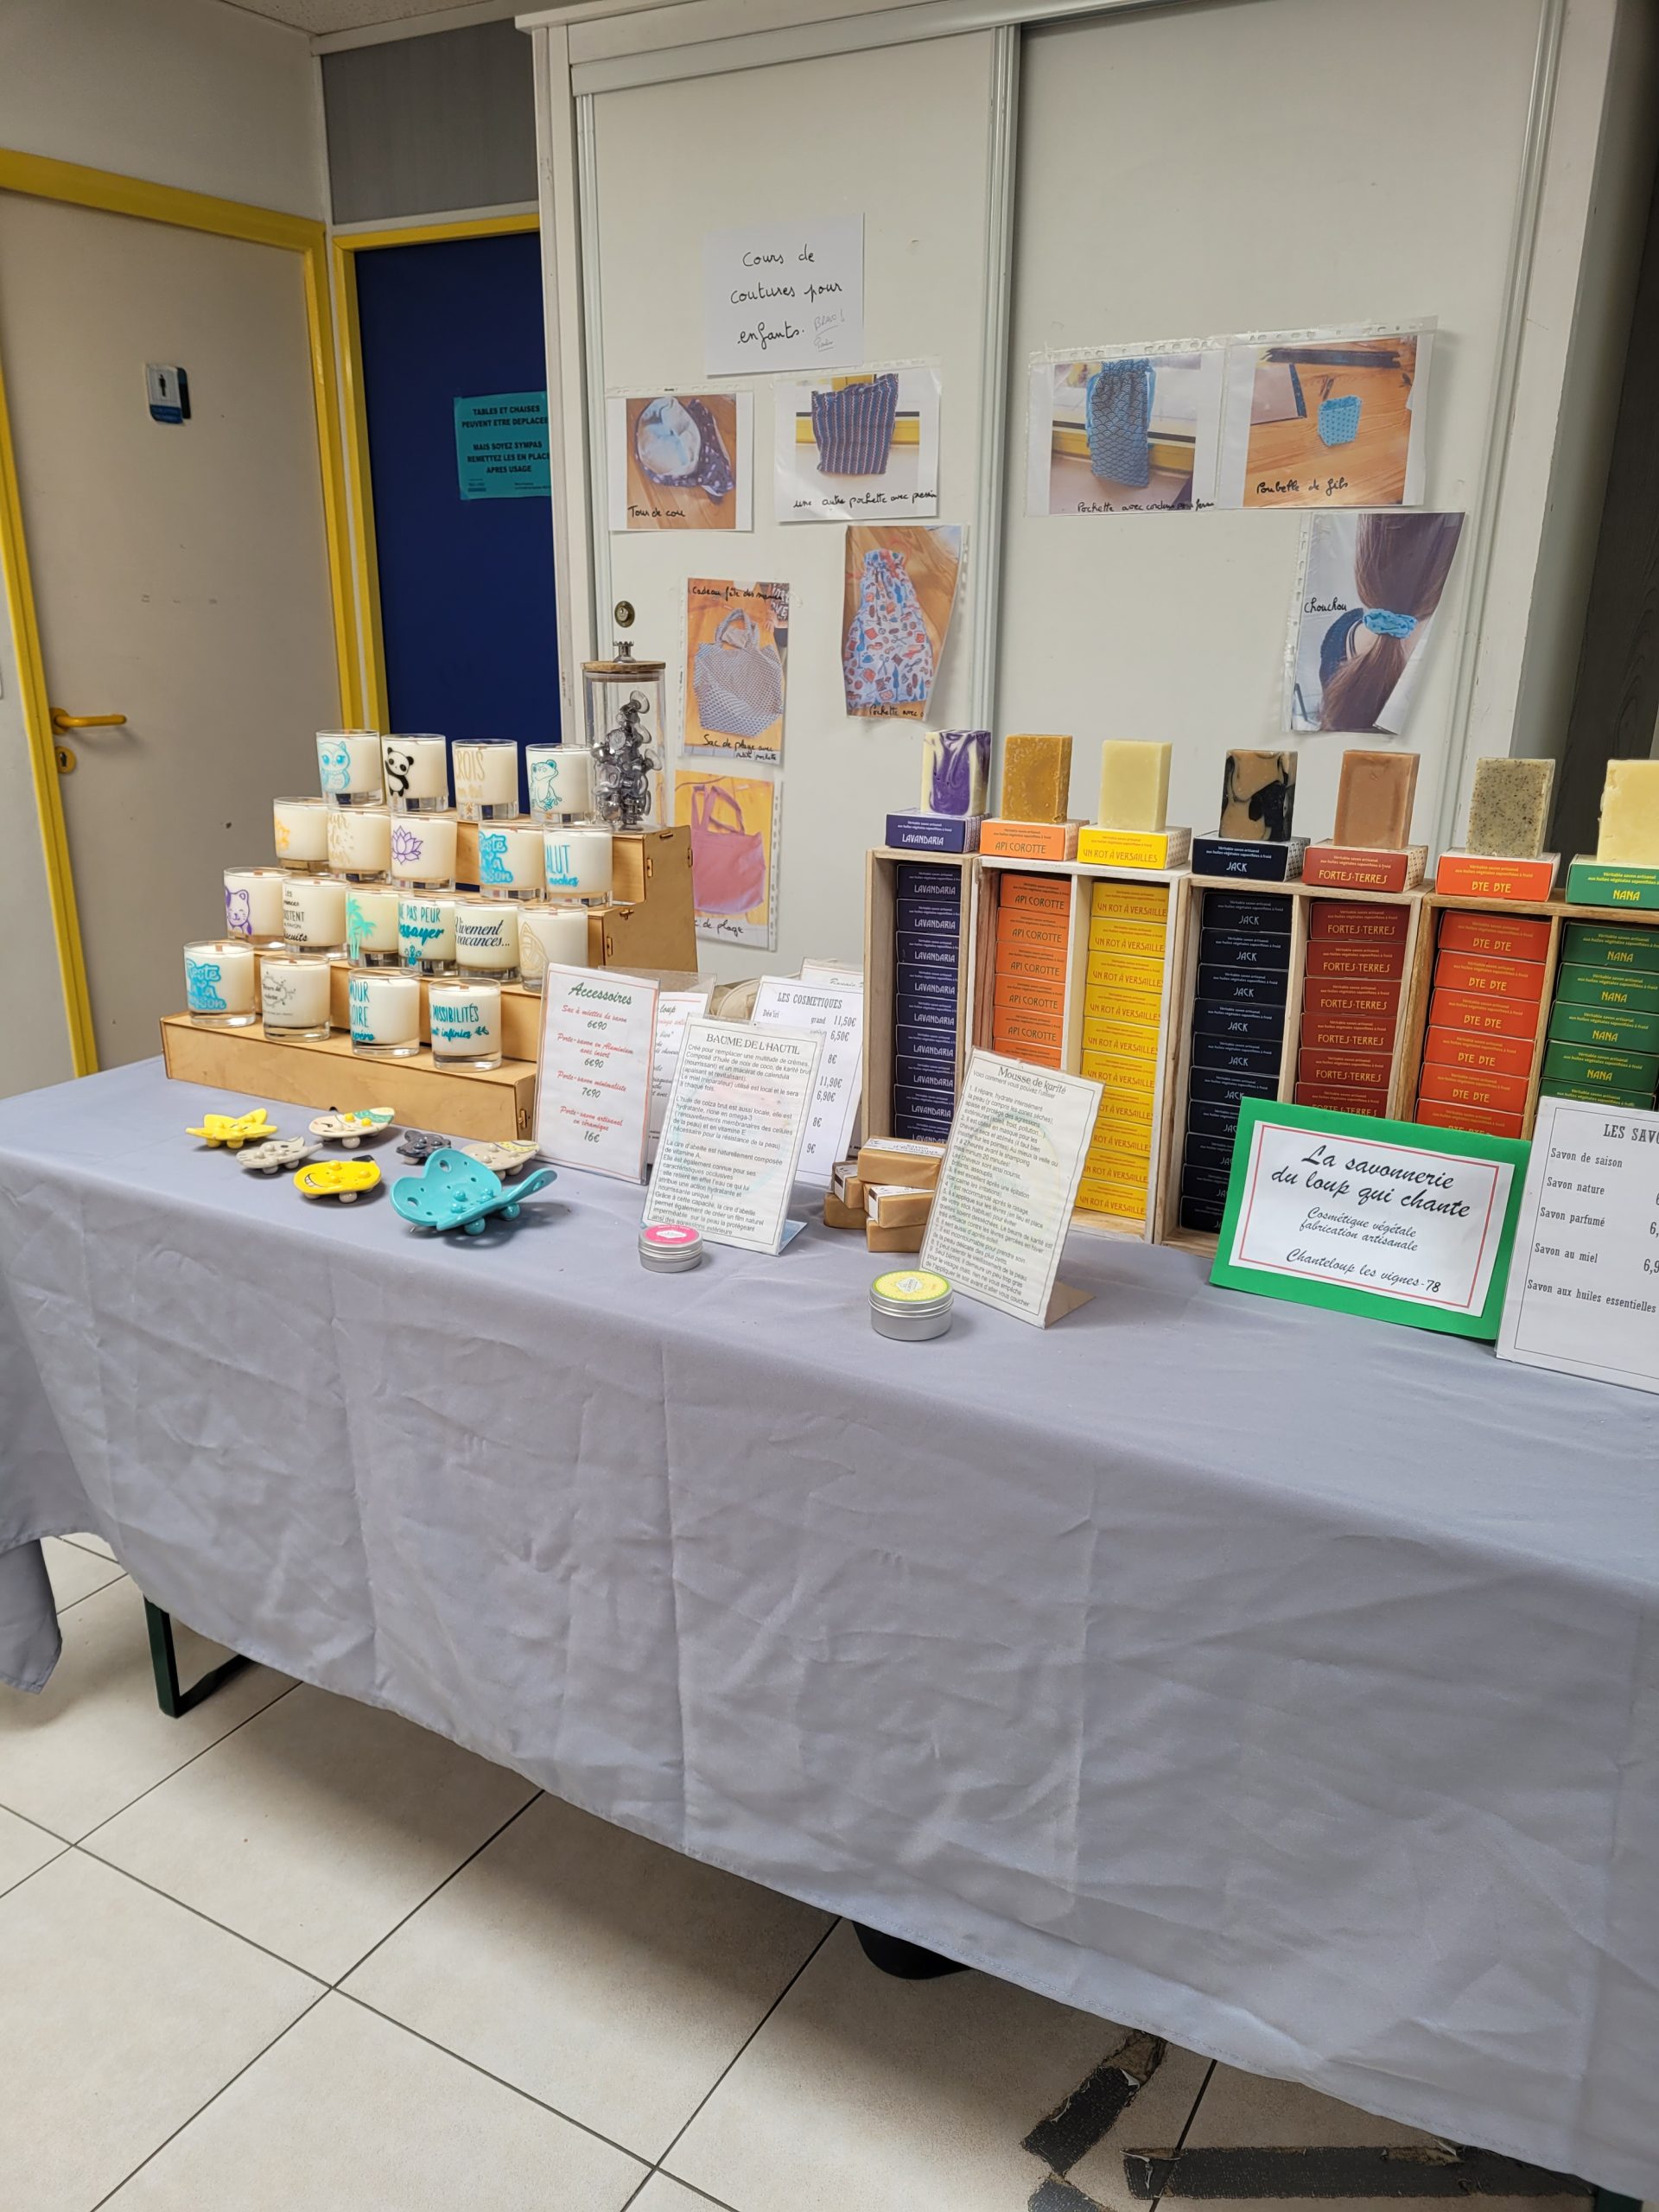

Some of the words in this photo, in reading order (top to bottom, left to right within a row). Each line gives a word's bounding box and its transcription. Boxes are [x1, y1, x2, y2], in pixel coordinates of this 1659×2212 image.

[742, 251, 784, 267] Cours
[798, 243, 815, 263] de
[730, 282, 796, 304] coutures
[804, 283, 842, 302] pour
[473, 407, 498, 416] TABLES
[510, 404, 540, 414] CHAISES
[461, 419, 492, 429] PEUVENT
[473, 443, 490, 452] MAIS
[515, 441, 543, 449] SYMPAS
[467, 454, 501, 463] REMETTEZ
[1308, 479, 1319, 491] de
[1325, 477, 1348, 496] fils
[627, 505, 650, 518] Tour
[652, 508, 662, 518] de
[1077, 501, 1114, 512] Pochette
[692, 587, 721, 595] Cadeau
[703, 734, 720, 747] Sac
[722, 738, 732, 748] de
[734, 740, 755, 753] plage
[901, 833, 944, 847] LAVANDARIA
[995, 841, 1008, 851] API
[1009, 842, 1046, 855] COROTTE
[1083, 849, 1093, 857] UN
[1094, 849, 1108, 859] ROT
[1116, 851, 1158, 863] VERSAILLES
[1226, 861, 1248, 873] JACK
[914, 884, 956, 896] LAVANDARIA
[1471, 880, 1490, 893] BYE
[1493, 882, 1511, 893] BYE
[1612, 889, 1641, 901] NANA
[1014, 894, 1027, 905] API
[1028, 897, 1065, 910] COROTTE
[406, 905, 417, 922] PAS
[421, 906, 441, 924] PEUR
[1238, 915, 1259, 925] JACK
[703, 918, 712, 929] de
[717, 920, 744, 937] plage
[914, 918, 956, 930] LAVANDARIA
[1472, 938, 1490, 950] BYE
[1494, 940, 1511, 951] BYE
[914, 950, 956, 963] LAVANDARIA
[1236, 951, 1257, 962] JACK
[1607, 950, 1634, 963] NANA
[1468, 977, 1485, 988] BYE
[1490, 979, 1507, 991] BYE
[568, 982, 632, 1005] Accessoires
[1233, 988, 1254, 997] JACK
[1601, 991, 1628, 1003] NANA
[778, 992, 791, 1003] LES
[793, 994, 843, 1009] COSMETIQUES
[562, 1004, 574, 1014] Sac
[582, 1009, 602, 1018] miettes
[588, 1020, 607, 1031] 6€90
[810, 1016, 826, 1025] grand
[834, 1014, 856, 1027] 11,50€
[706, 1033, 743, 1047] BAUME
[744, 1039, 758, 1049] DE
[830, 1030, 850, 1042] 6,50€
[1592, 1030, 1618, 1042] NANA
[556, 1033, 593, 1046] Porte-savon
[602, 1042, 633, 1054] Aluminium
[594, 1050, 610, 1058] insert
[828, 1054, 837, 1065] 8€
[584, 1058, 604, 1069] 6€90
[557, 1071, 593, 1084] Porte-savon
[594, 1080, 626, 1092] minimaliste
[820, 1076, 842, 1089] 11,90€
[998, 1066, 1032, 1084] Mousse
[1033, 1077, 1043, 1088] de
[1043, 1080, 1067, 1095] karité
[582, 1087, 601, 1098] 7€90
[817, 1091, 836, 1103] 6,90€
[560, 1106, 595, 1119] Porte-savon
[597, 1115, 623, 1127] artisanal
[812, 1117, 822, 1128] 8€
[584, 1130, 601, 1143] 16€
[1603, 1123, 1625, 1139] LES
[807, 1143, 817, 1154] 9€
[1550, 1147, 1576, 1161] Savon
[1580, 1151, 1591, 1164] de
[1595, 1154, 1623, 1168] saison
[1302, 1145, 1337, 1167] La
[1345, 1158, 1454, 1191] savonnerie
[1271, 1165, 1298, 1185] du
[1306, 1171, 1350, 1199] loup
[1358, 1185, 1395, 1206] qui
[1401, 1189, 1471, 1218] chante
[1547, 1176, 1573, 1191] Savon
[1576, 1180, 1605, 1195] nature
[1307, 1206, 1370, 1229] Cosmétique
[1372, 1219, 1417, 1238] végétale
[1540, 1207, 1566, 1222] Savon
[1569, 1211, 1605, 1228] parfumé
[1299, 1218, 1358, 1240] fabrication
[1362, 1231, 1418, 1252] artisanale
[1535, 1243, 1560, 1257] Savon
[1564, 1249, 1576, 1261] au
[1580, 1250, 1598, 1264] miel
[1286, 1248, 1356, 1274] Chanteloup
[1359, 1264, 1376, 1278] les
[1527, 1279, 1553, 1294] Savon
[1556, 1285, 1572, 1298] aux
[1576, 1287, 1602, 1303] huiles
[1605, 1294, 1656, 1313] essentielles
